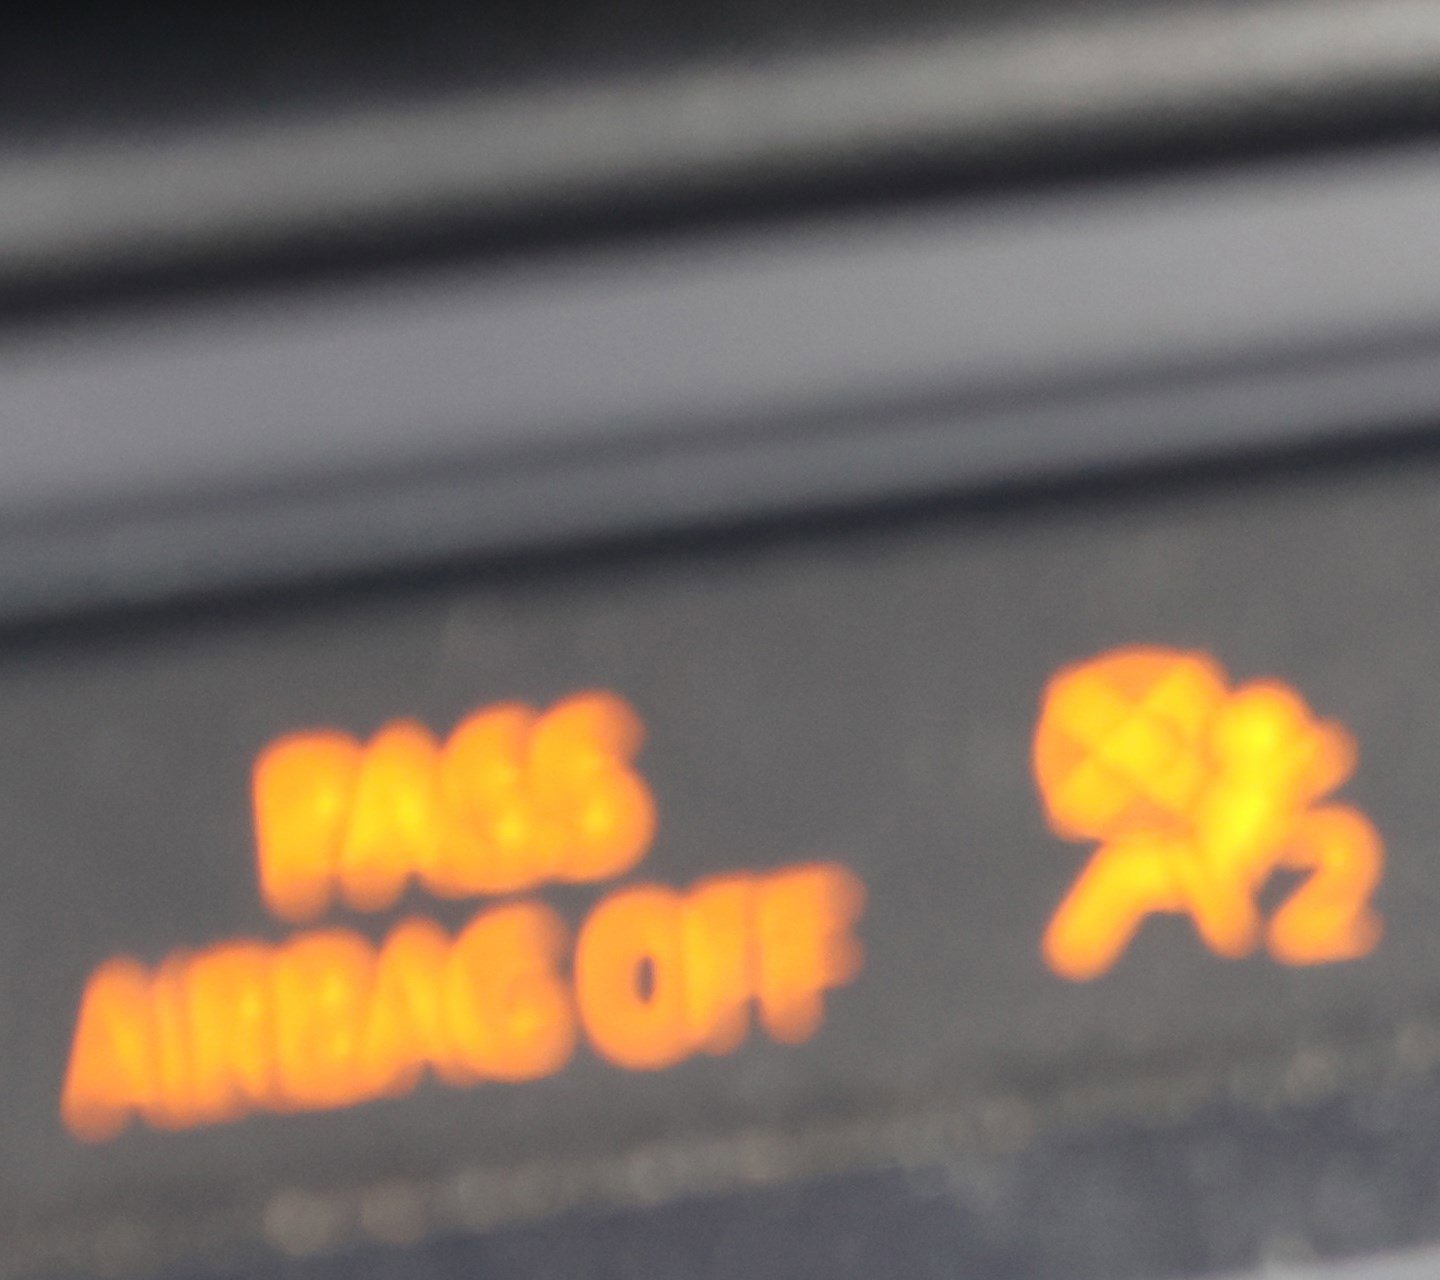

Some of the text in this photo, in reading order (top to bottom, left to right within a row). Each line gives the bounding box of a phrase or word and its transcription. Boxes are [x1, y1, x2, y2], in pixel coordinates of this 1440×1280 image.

[252, 691, 656, 922] PASS
[61, 864, 867, 1143] AIRBAG OFF
